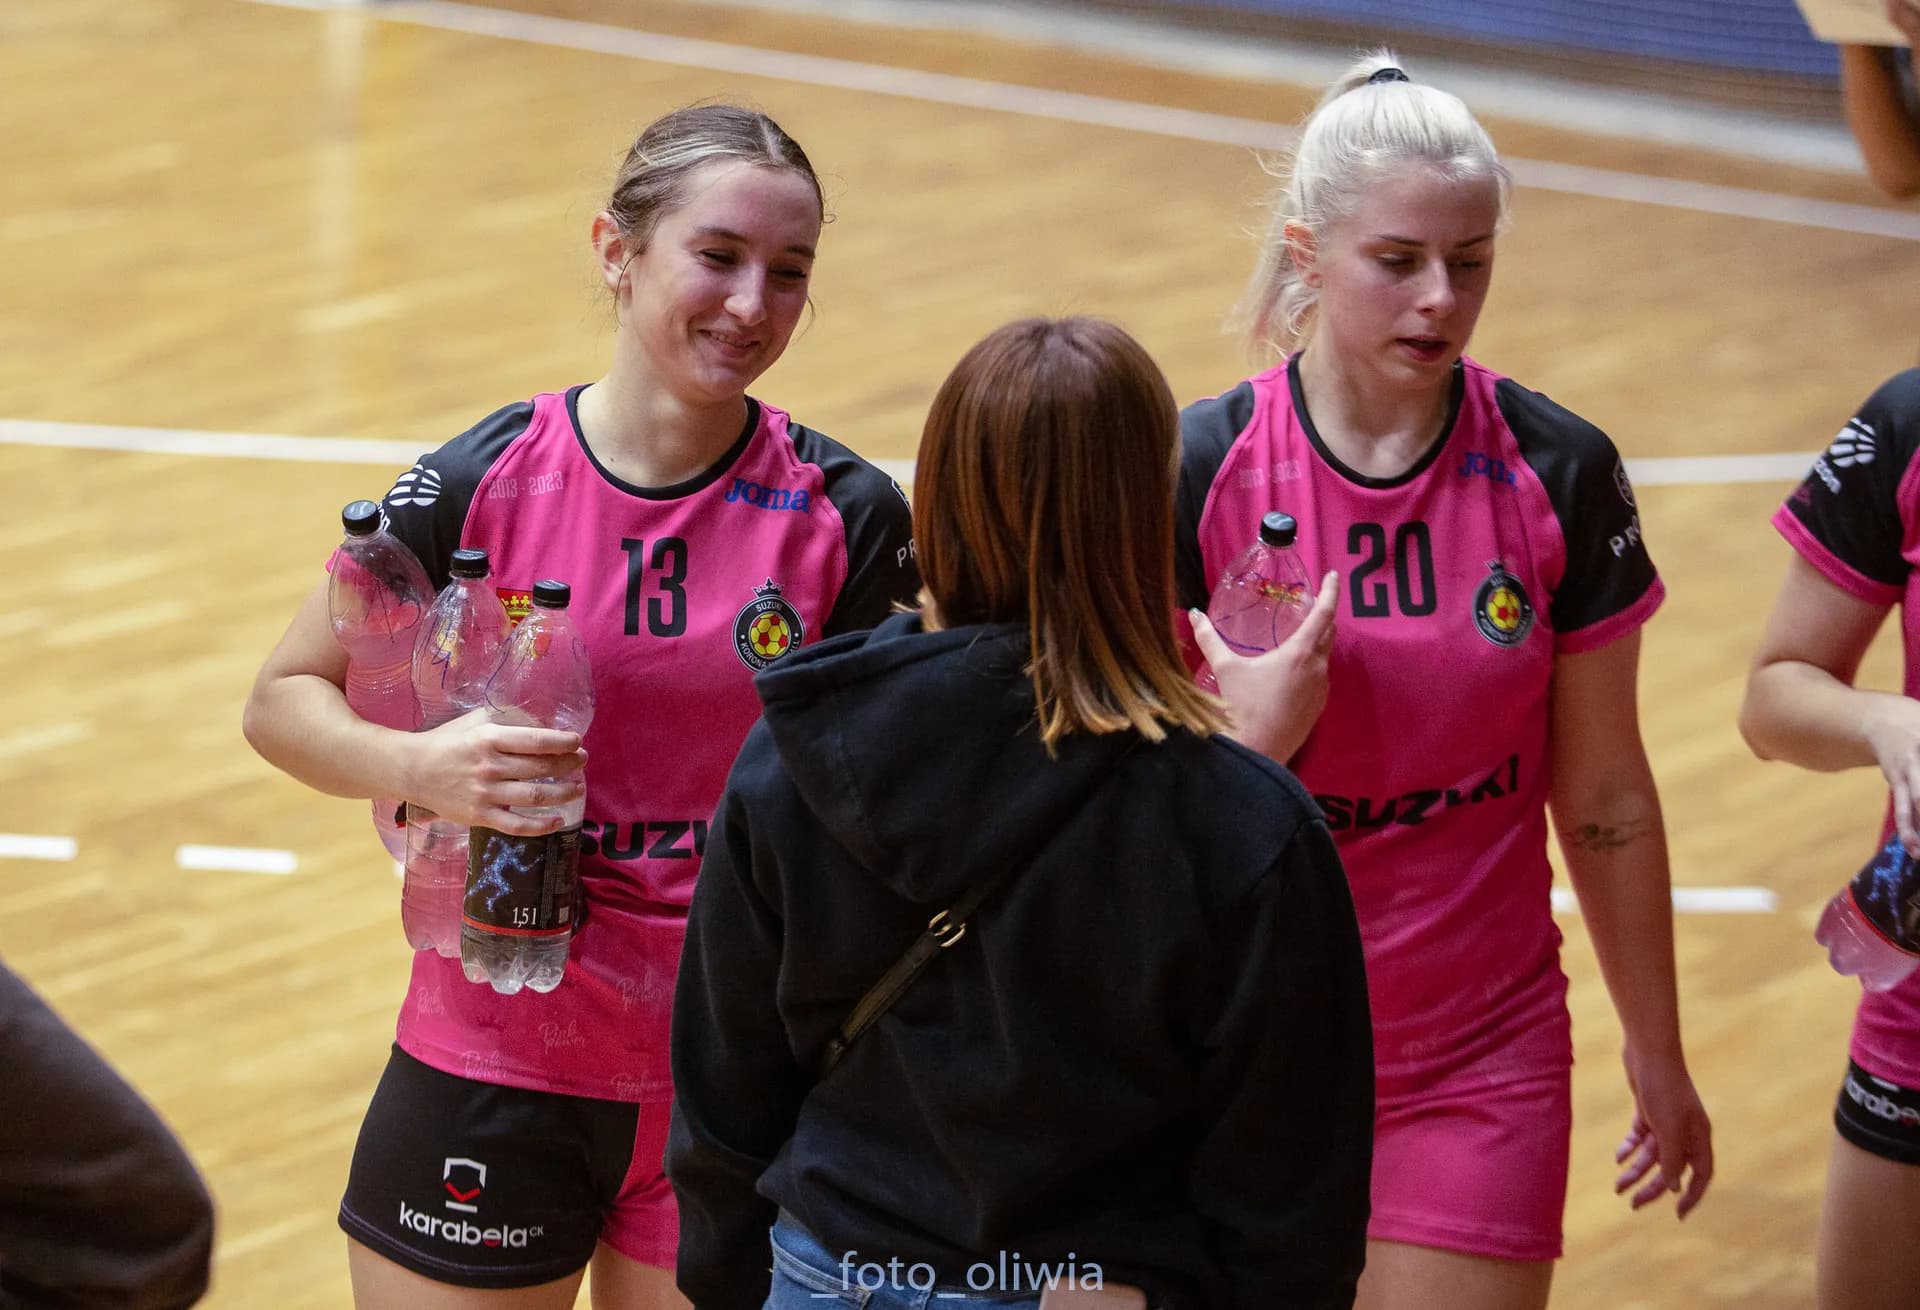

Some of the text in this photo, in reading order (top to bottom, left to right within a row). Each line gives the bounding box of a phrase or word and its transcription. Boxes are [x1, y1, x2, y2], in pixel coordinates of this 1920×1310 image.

[488, 477, 518, 499] 2013
[529, 471, 564, 497] 2023
[724, 478, 810, 513] Joma
[621, 536, 688, 638] 13
[1347, 520, 1437, 618] 20
[580, 819, 709, 860] UZ
[400, 1200, 544, 1249] karabela CK
